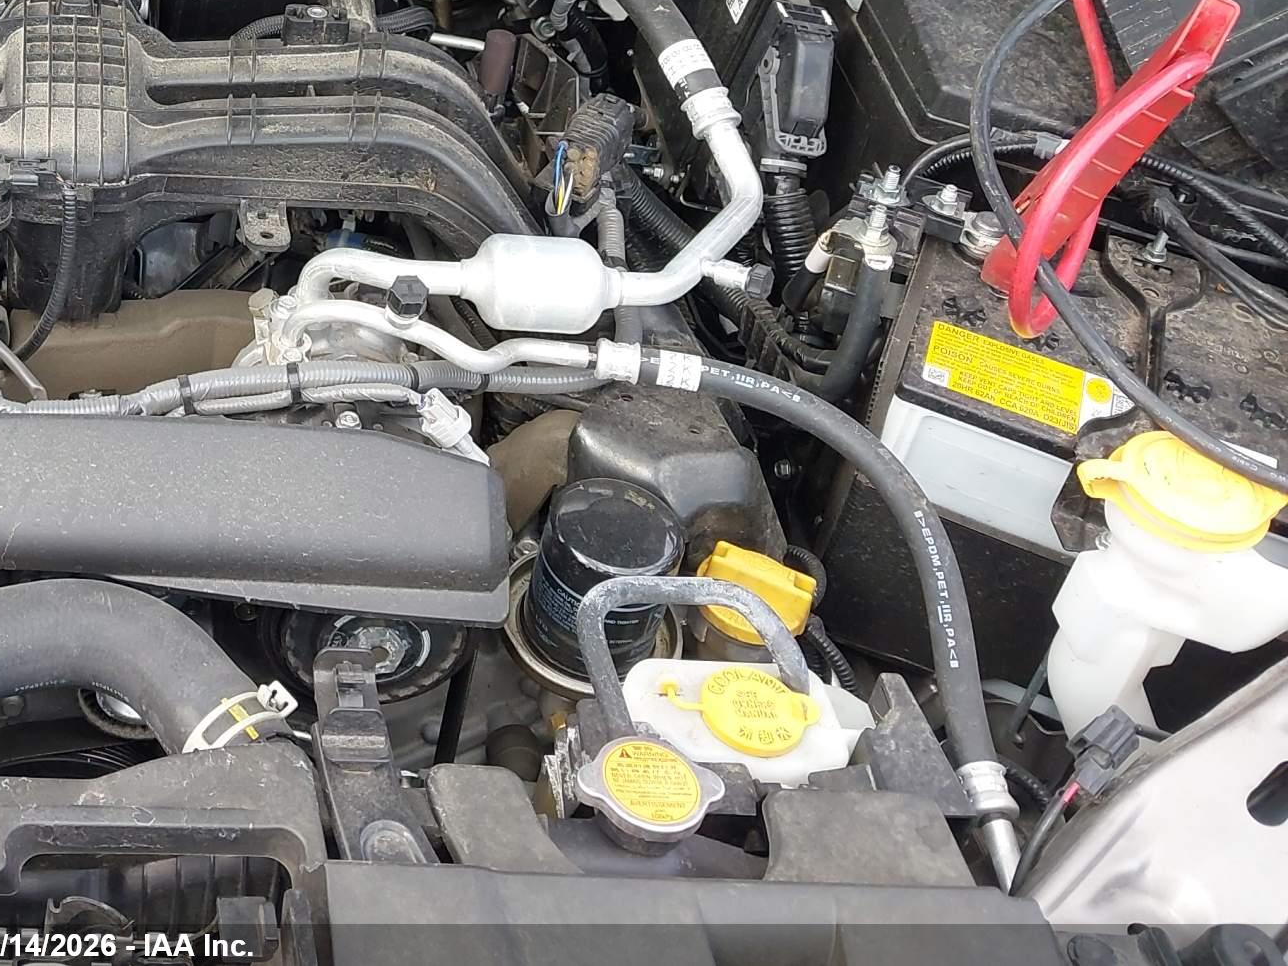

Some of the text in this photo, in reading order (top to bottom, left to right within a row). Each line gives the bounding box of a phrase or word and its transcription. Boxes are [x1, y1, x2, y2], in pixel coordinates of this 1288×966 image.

[937, 323, 980, 342] DANGER
[982, 339, 1020, 356] EXPLOSIVE
[933, 345, 973, 364] POISON
[979, 361, 1006, 375] CAUSES
[998, 398, 1018, 411] CCA
